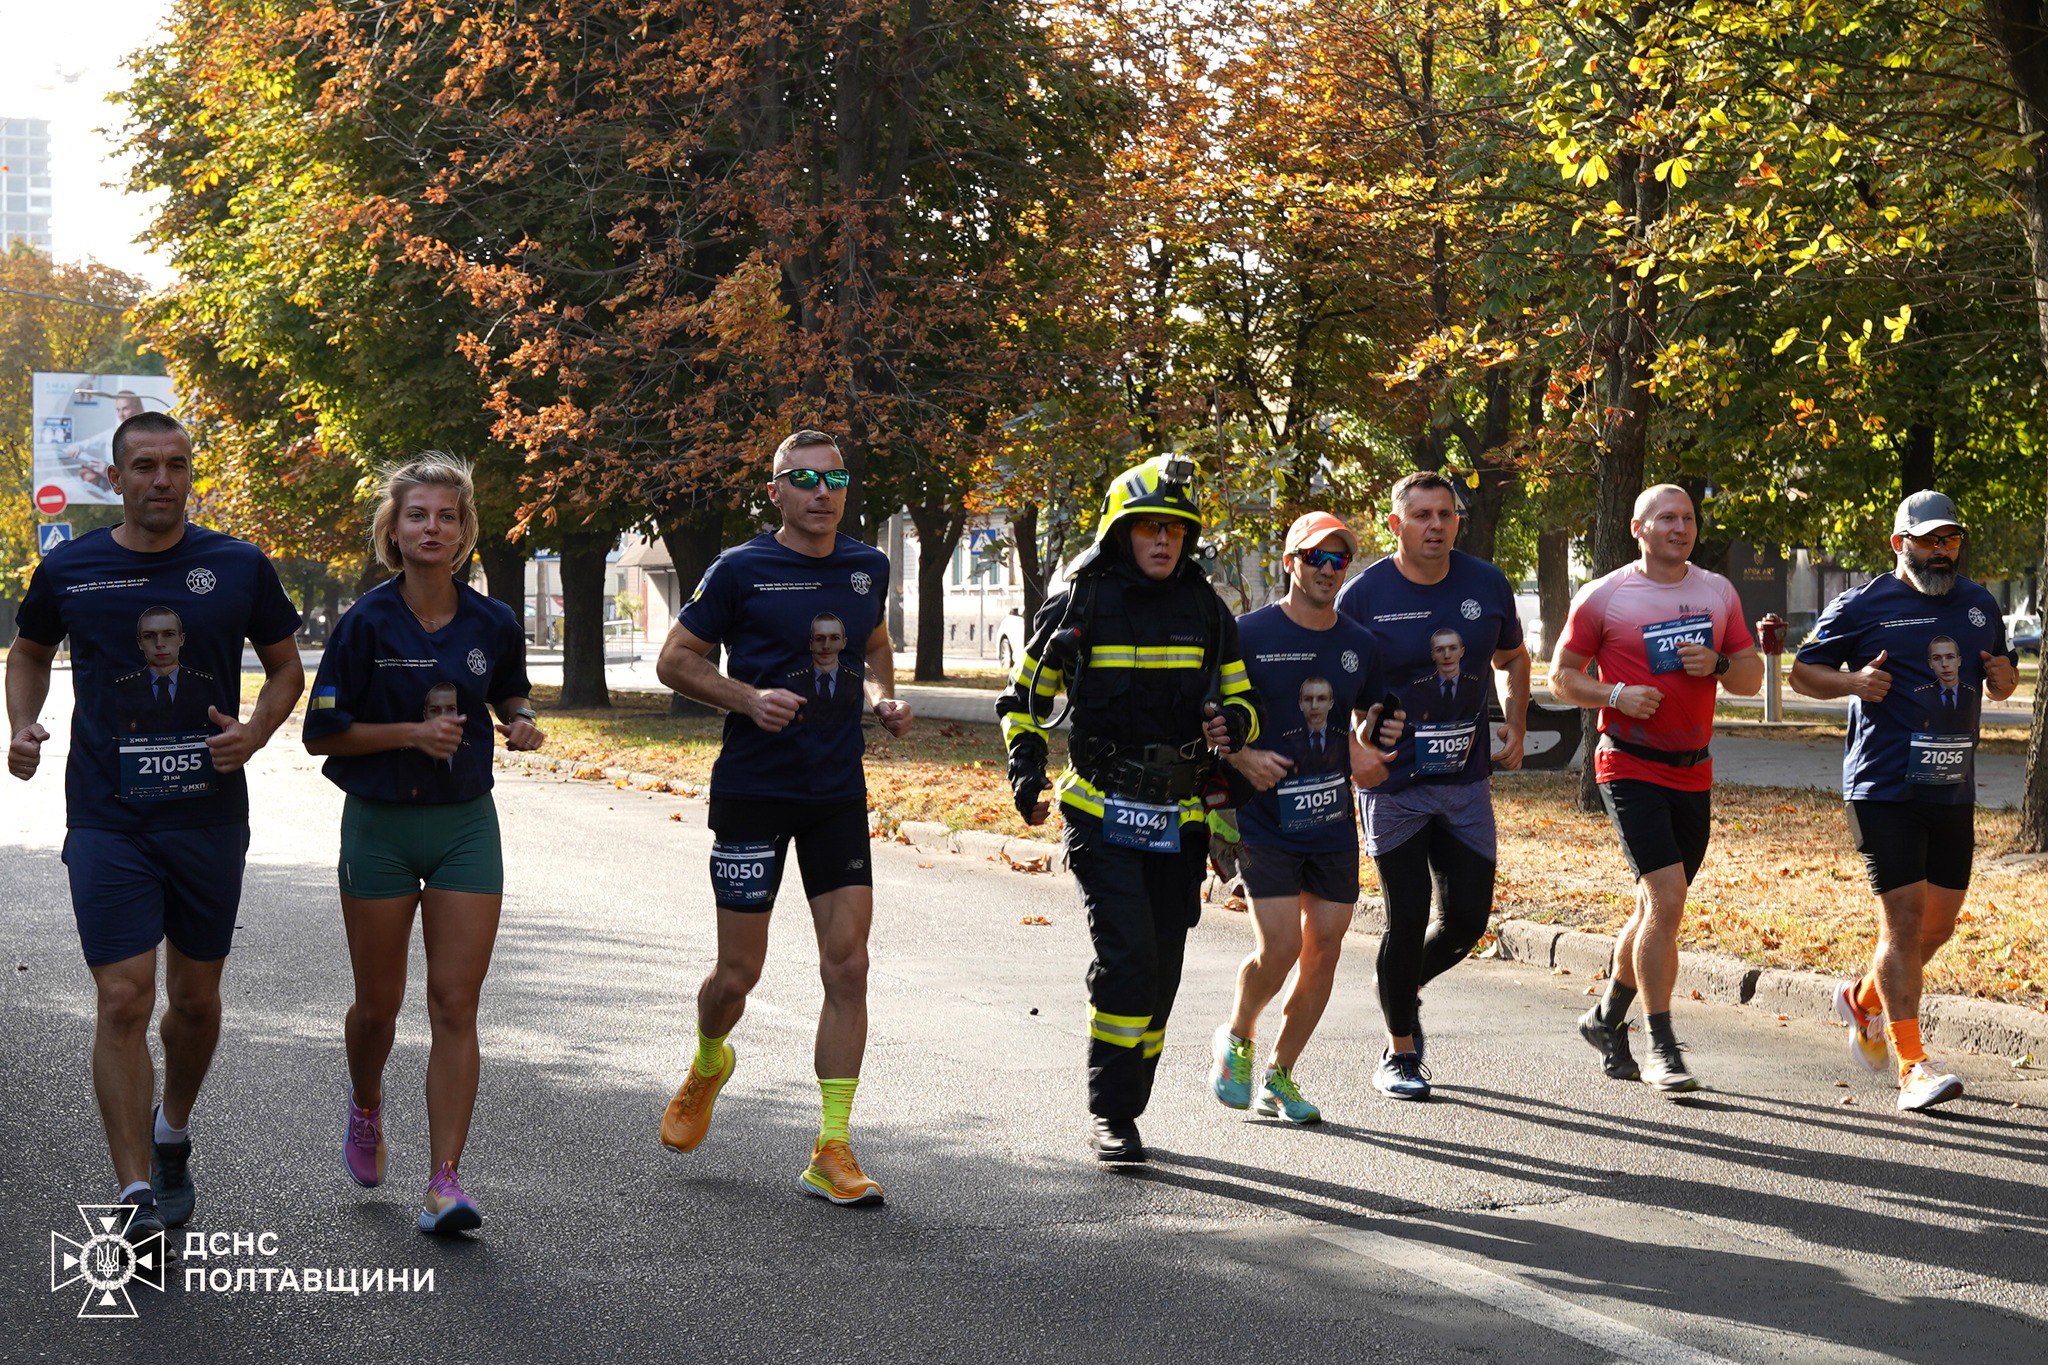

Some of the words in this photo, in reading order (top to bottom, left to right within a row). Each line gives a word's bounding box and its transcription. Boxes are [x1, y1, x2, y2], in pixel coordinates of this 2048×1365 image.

[1427, 735, 1470, 754] 21059
[138, 753, 202, 775] 21055
[1920, 750, 1964, 764] 21056
[1293, 788, 1337, 811] 21051
[1116, 808, 1168, 831] 21049
[715, 861, 765, 880] 21050
